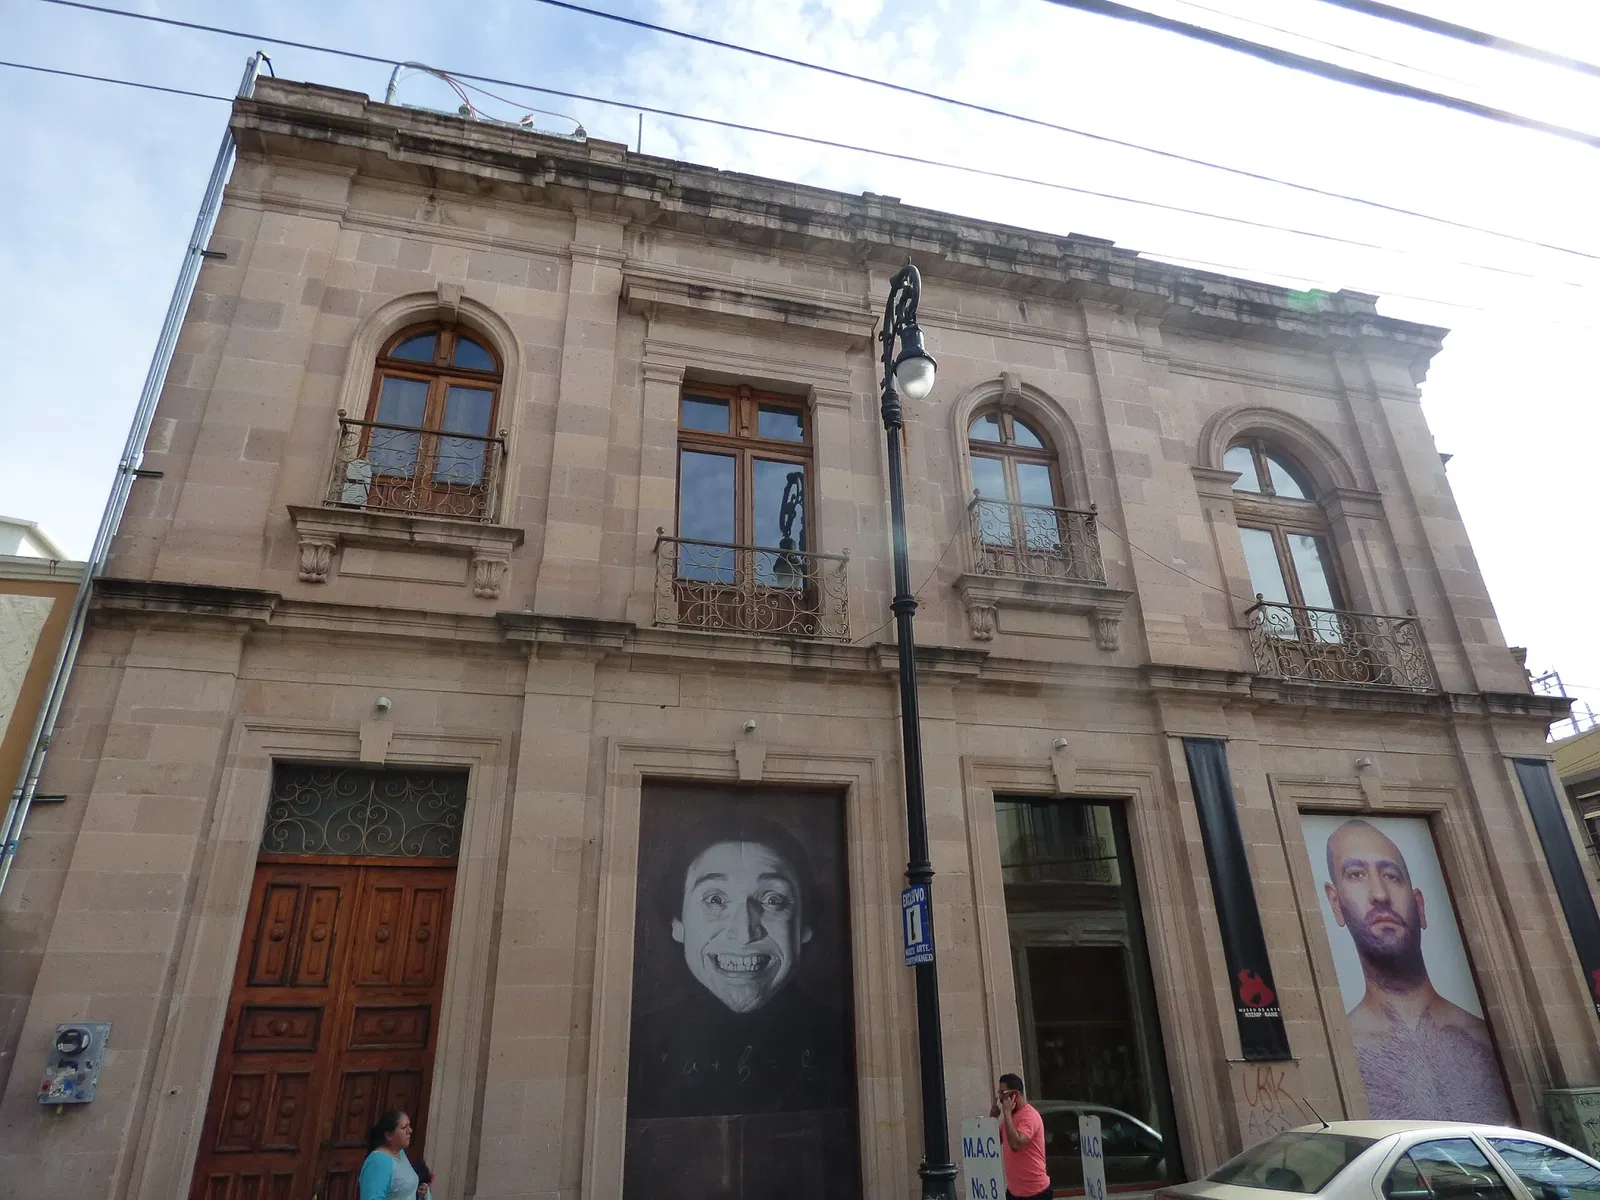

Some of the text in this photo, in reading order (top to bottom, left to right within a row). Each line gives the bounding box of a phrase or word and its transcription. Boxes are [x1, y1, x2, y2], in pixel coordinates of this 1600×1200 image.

[963, 1136, 999, 1158] M.A.C.
[971, 1177, 998, 1200] No. 8
